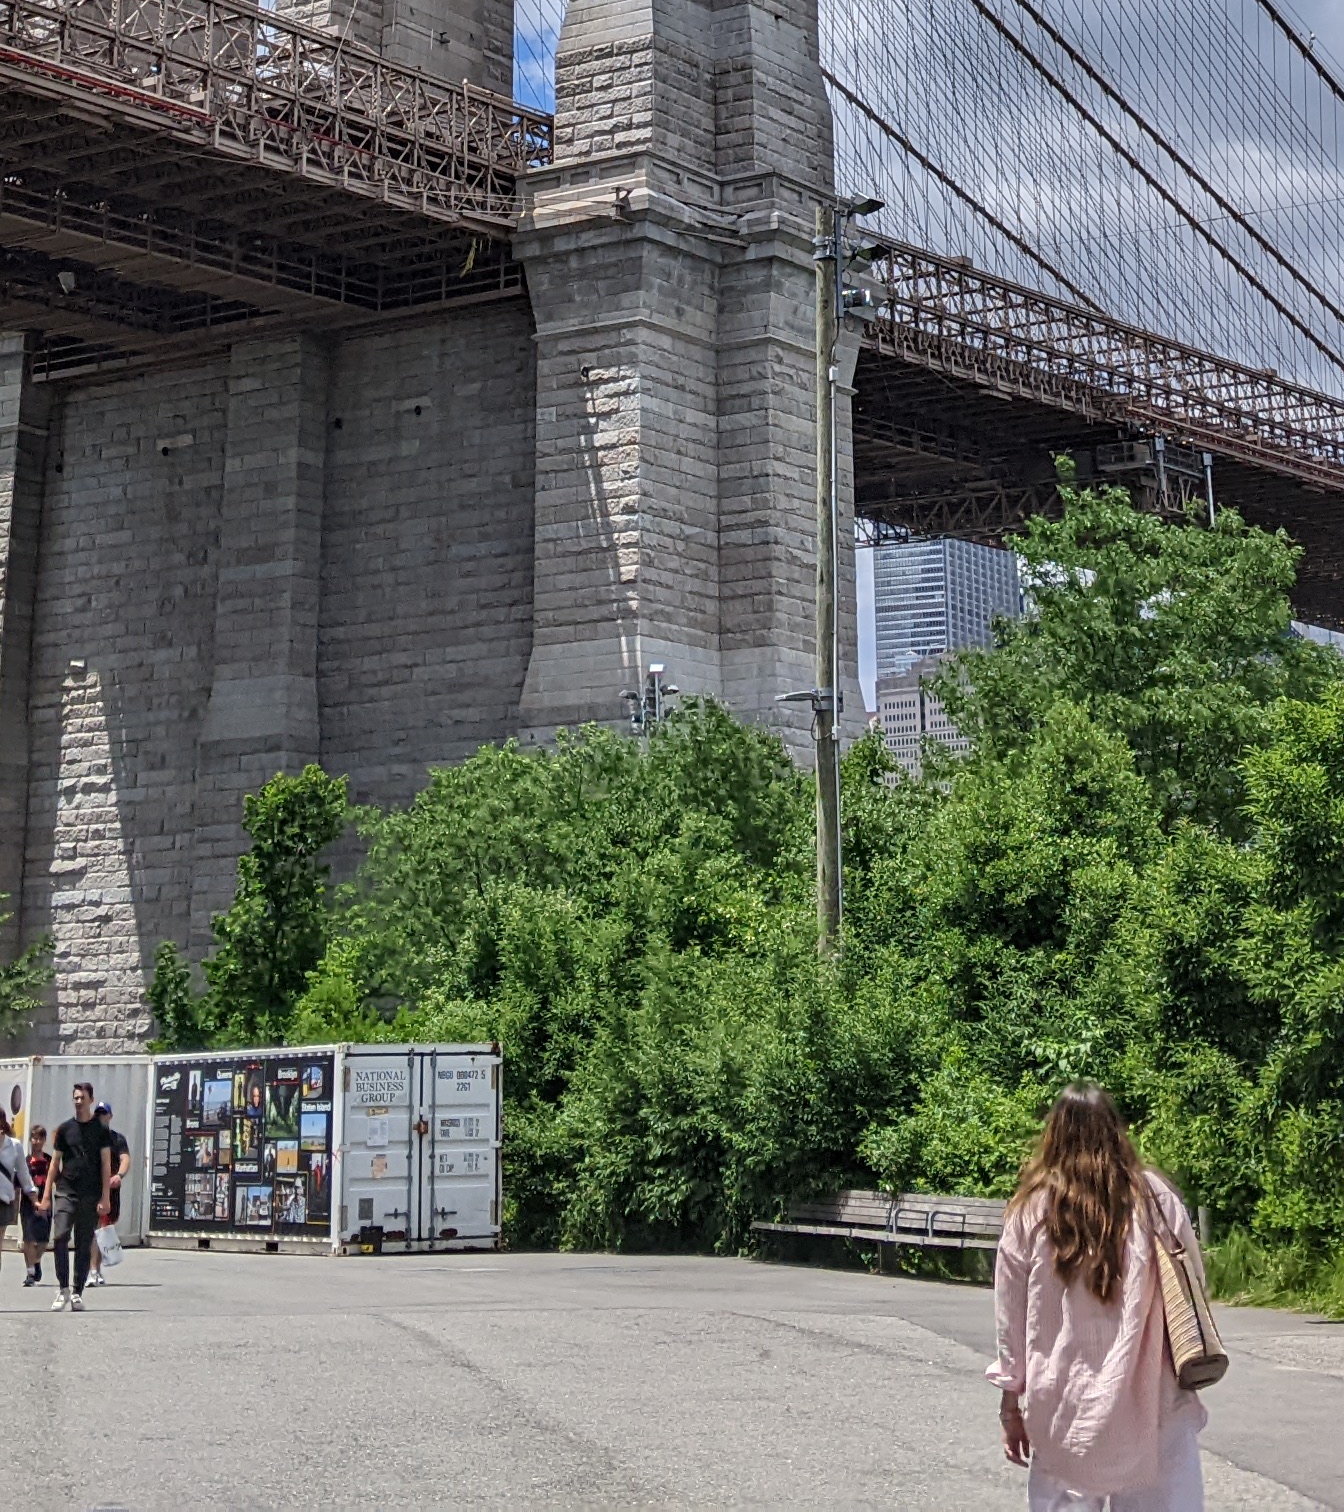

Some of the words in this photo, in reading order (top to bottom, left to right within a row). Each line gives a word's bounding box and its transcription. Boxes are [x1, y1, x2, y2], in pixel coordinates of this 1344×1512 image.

[356, 1071, 406, 1081] NATIONAL
[356, 1082, 404, 1092] BUSINESS
[361, 1093, 396, 1103] GROUP
